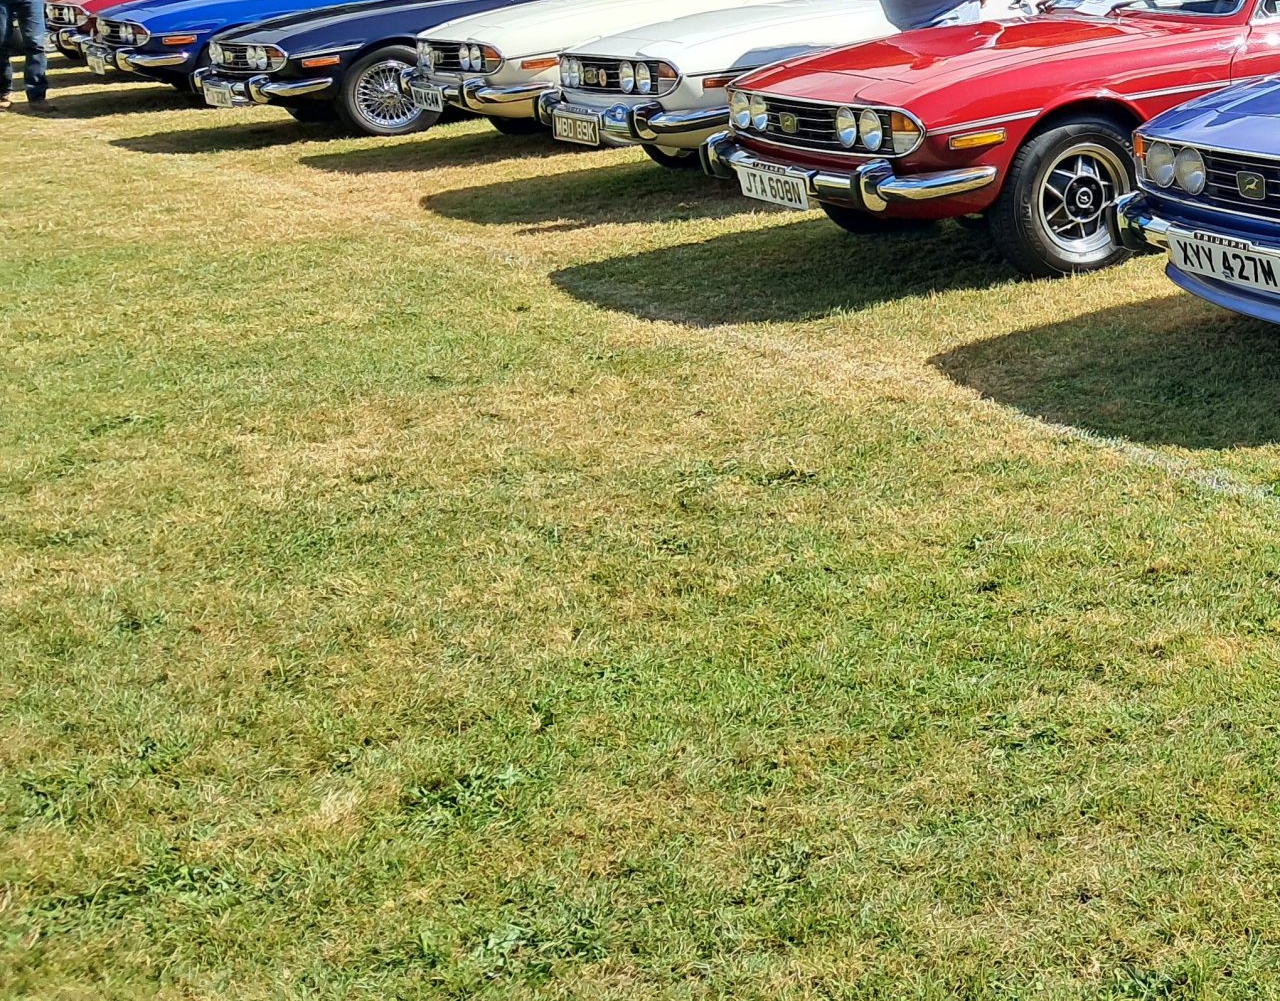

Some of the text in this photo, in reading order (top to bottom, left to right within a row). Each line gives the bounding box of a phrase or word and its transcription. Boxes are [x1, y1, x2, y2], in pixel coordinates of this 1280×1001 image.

[576, 120, 596, 142] 89K
[746, 171, 802, 205] JTA 608N
[1196, 232, 1248, 250] TRIUMPH
[1177, 240, 1278, 287] XYY 427M
